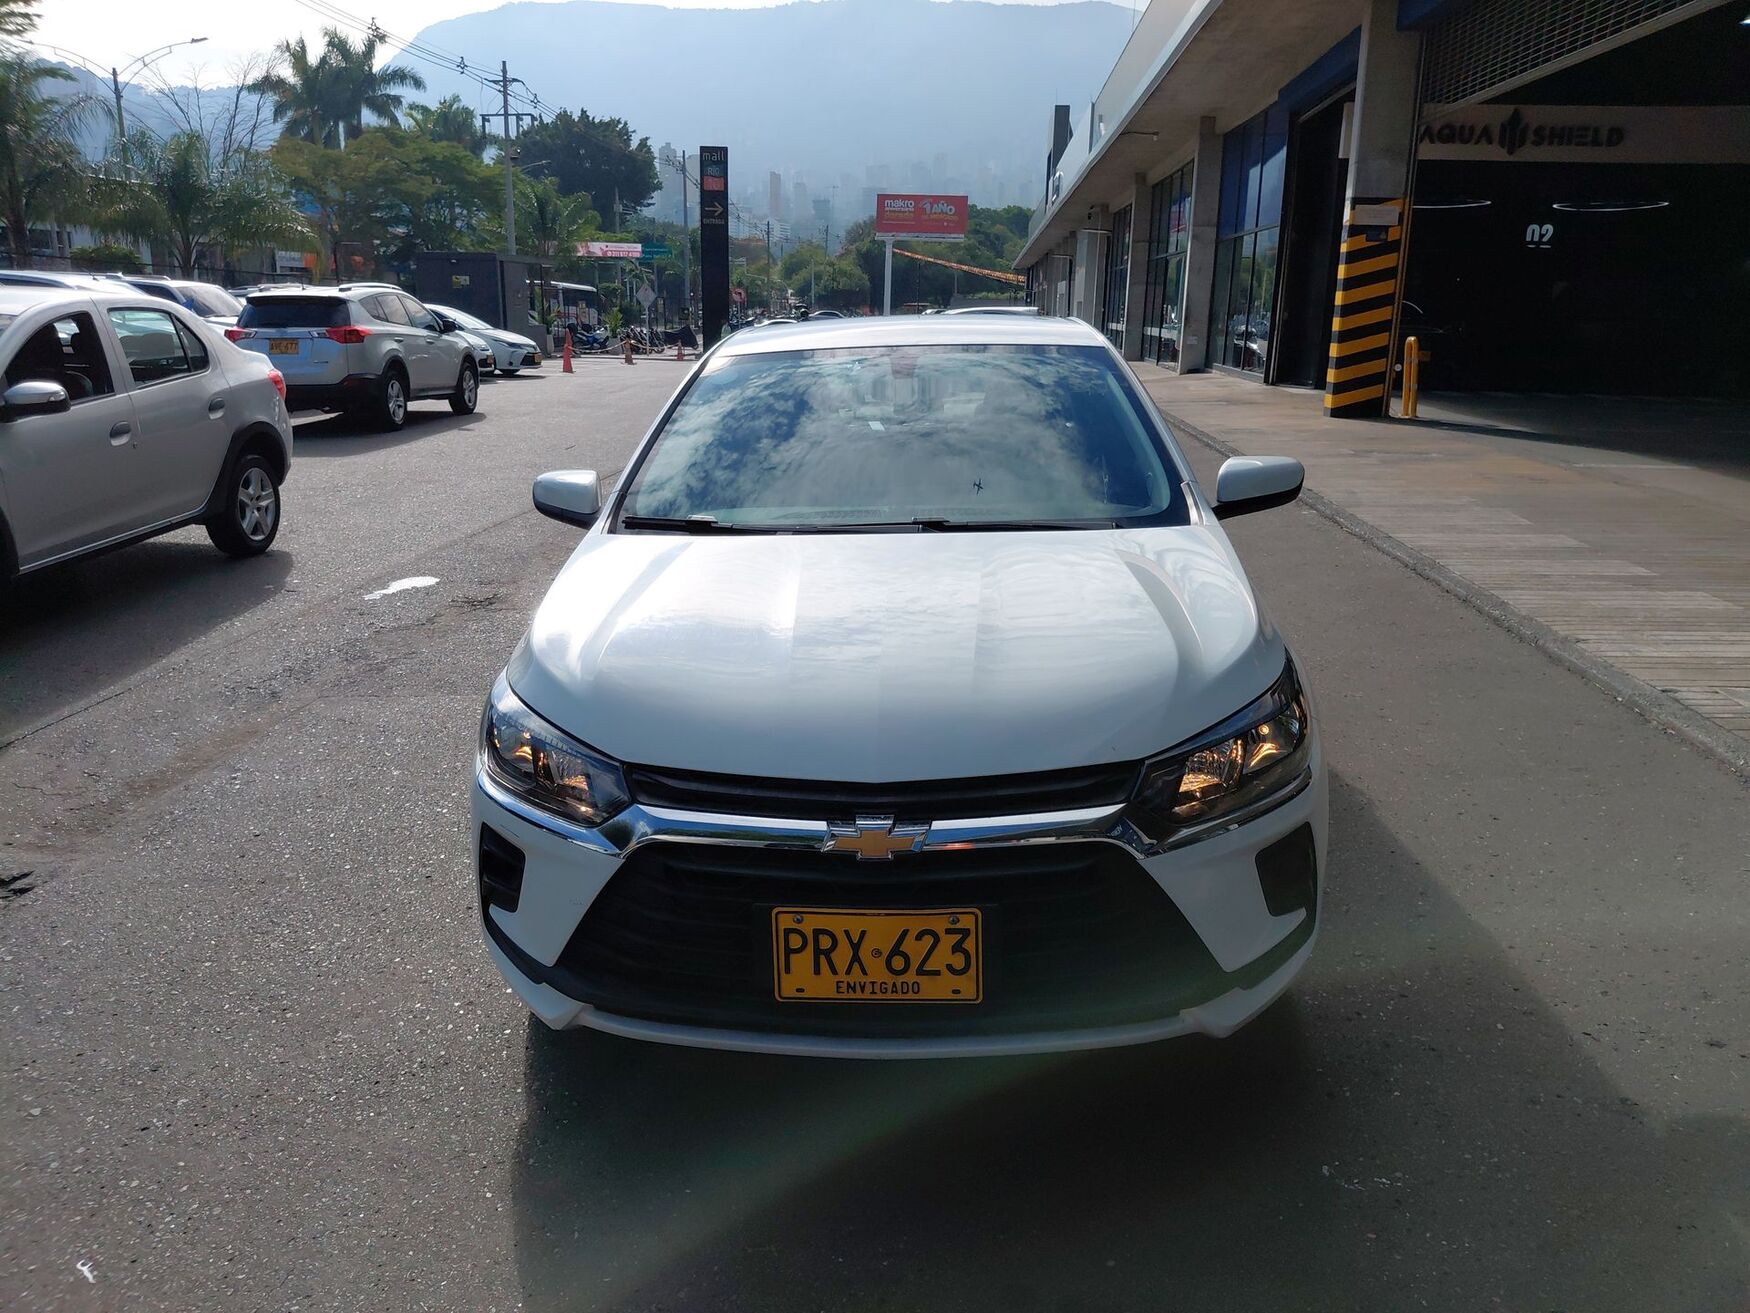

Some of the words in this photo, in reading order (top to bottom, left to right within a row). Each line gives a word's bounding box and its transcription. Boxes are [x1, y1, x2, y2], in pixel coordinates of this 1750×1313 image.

[1420, 124, 1493, 145] AQUA
[1532, 126, 1624, 147] SHIELD
[703, 151, 724, 161] mall
[885, 199, 915, 208] makro
[932, 201, 955, 215] AÑO
[782, 927, 869, 976] PRX
[884, 927, 972, 976] 623
[835, 980, 921, 995] ENVIGADO
